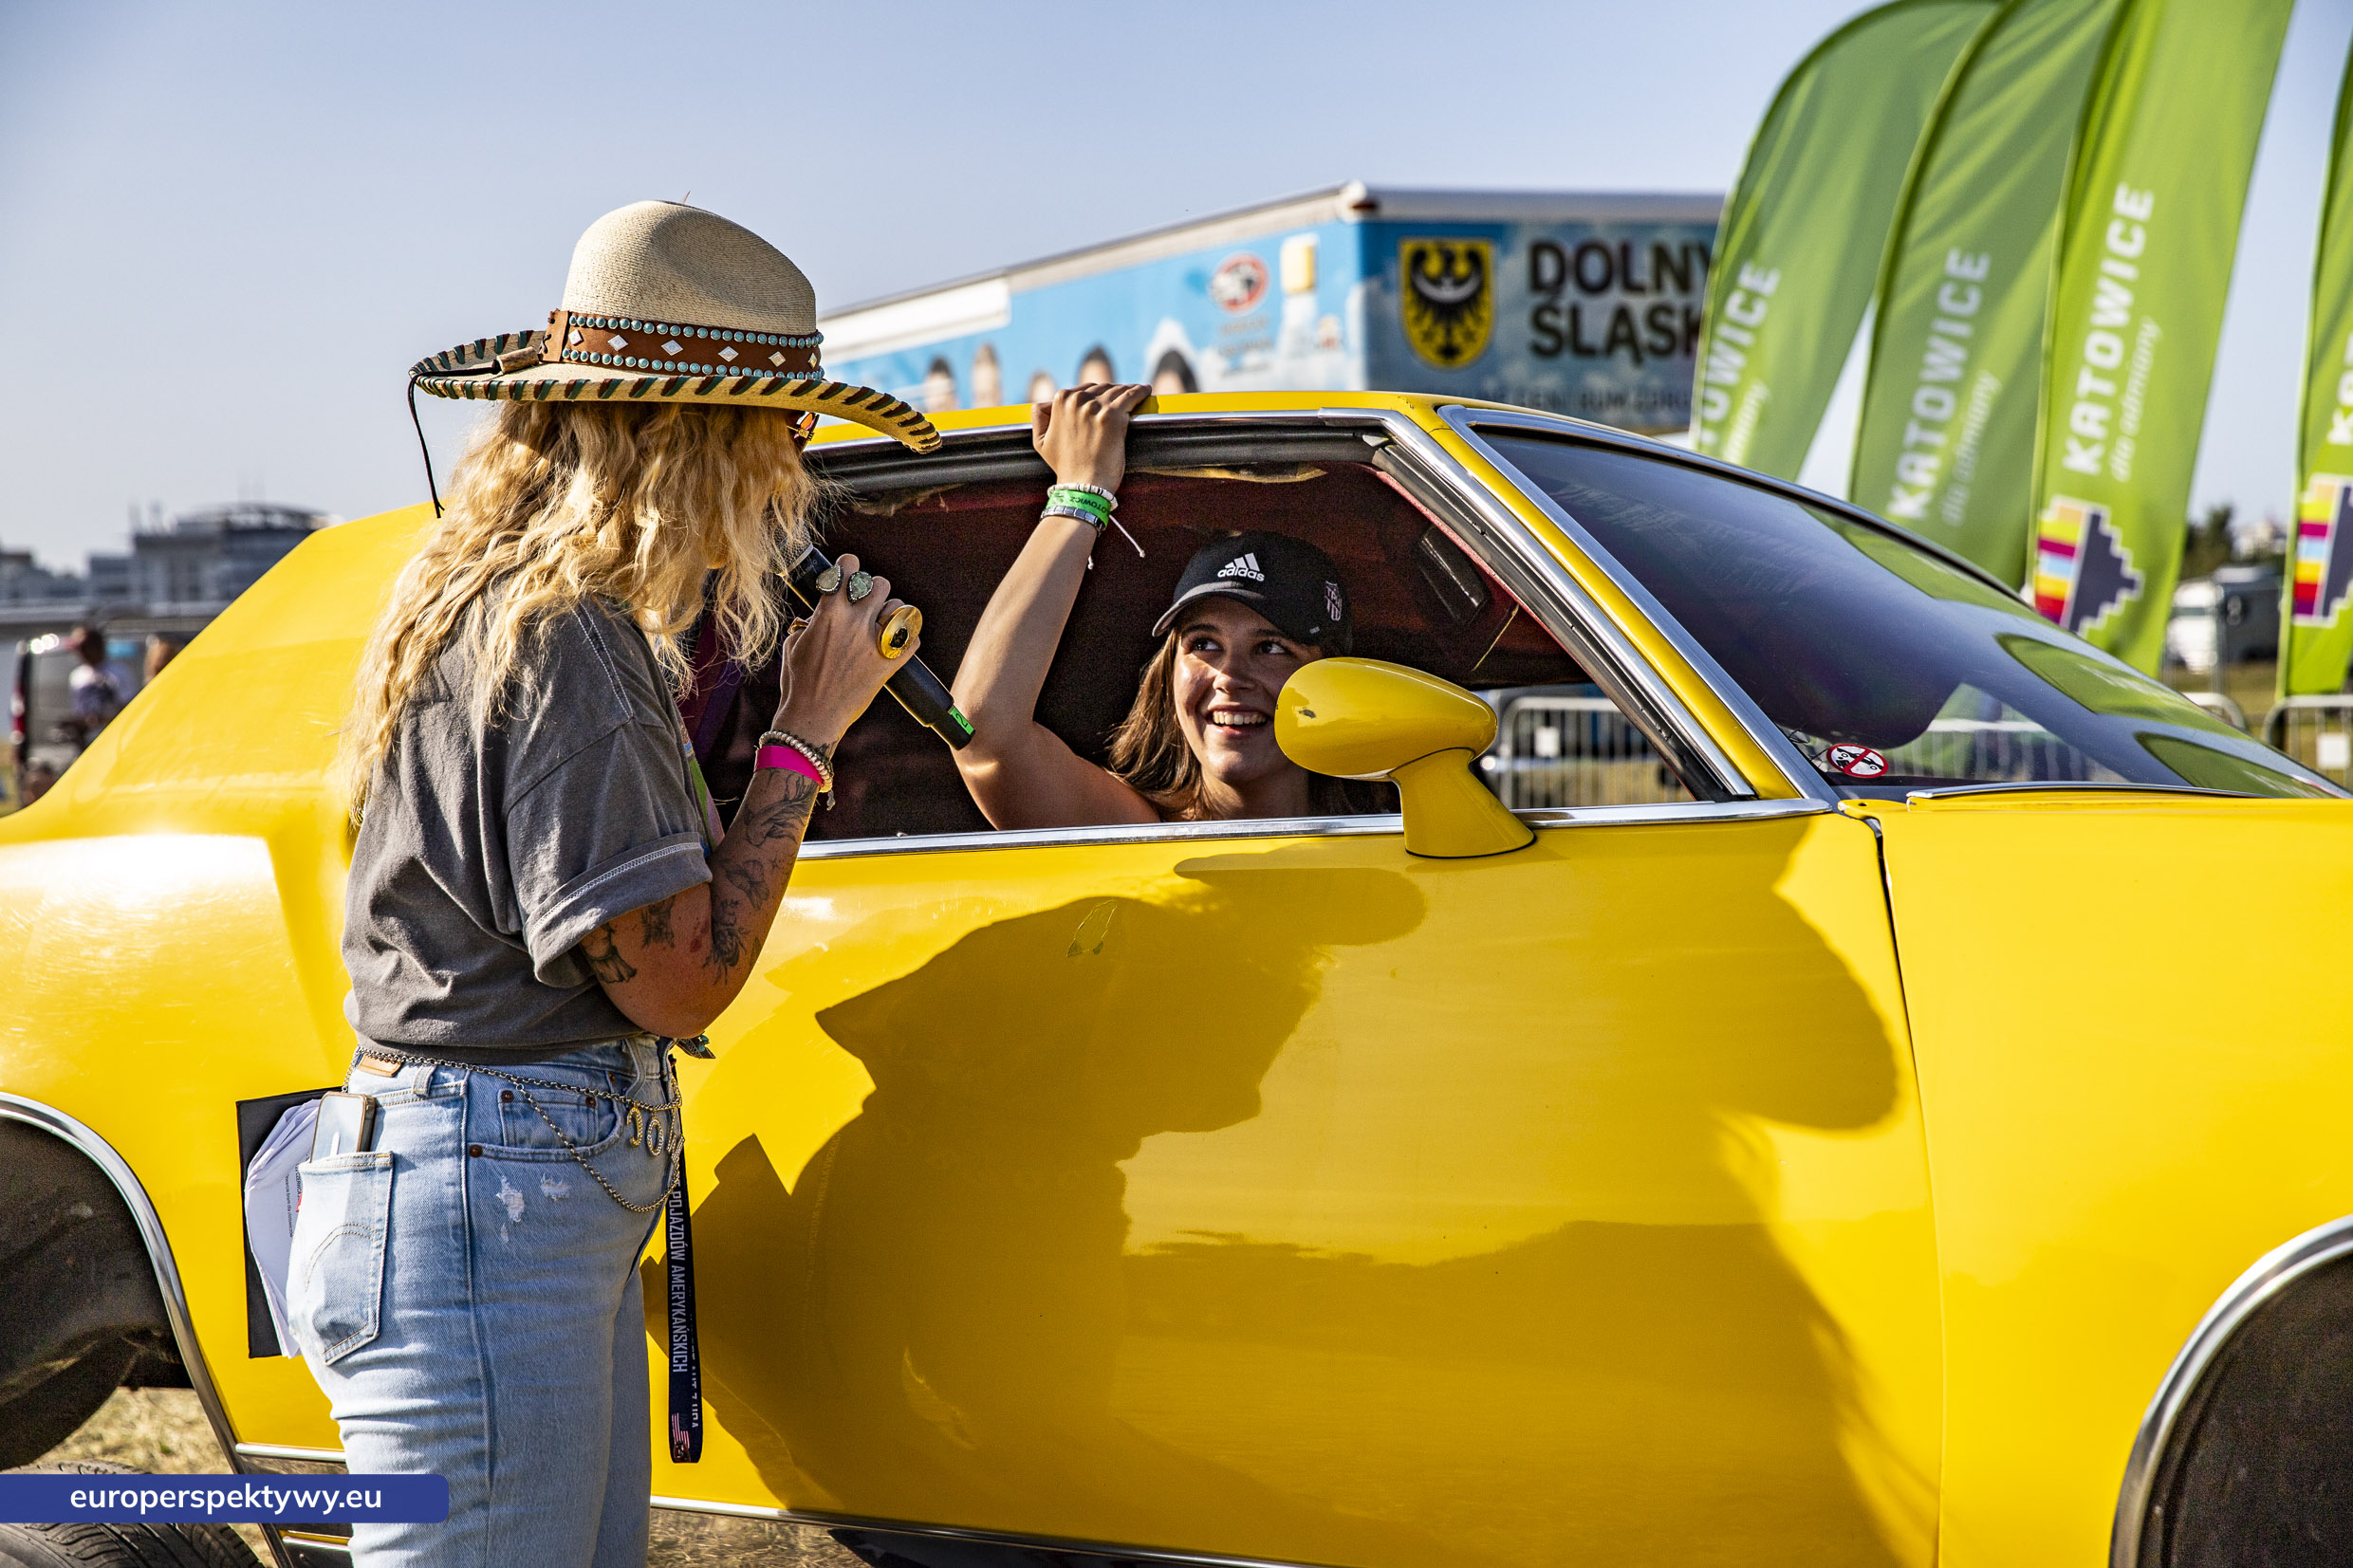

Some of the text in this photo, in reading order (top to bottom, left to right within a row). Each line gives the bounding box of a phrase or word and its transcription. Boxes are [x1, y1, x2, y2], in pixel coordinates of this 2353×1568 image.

[1700, 259, 1781, 445] OWICE
[2062, 181, 2156, 475] KATOWICE
[1886, 246, 1992, 521] KATOWICE
[1217, 566, 1265, 581] adidas
[955, 712, 969, 729] 2
[669, 1190, 689, 1261] POJAZDÓW
[671, 1264, 690, 1373] AMERYKAŃSKICH
